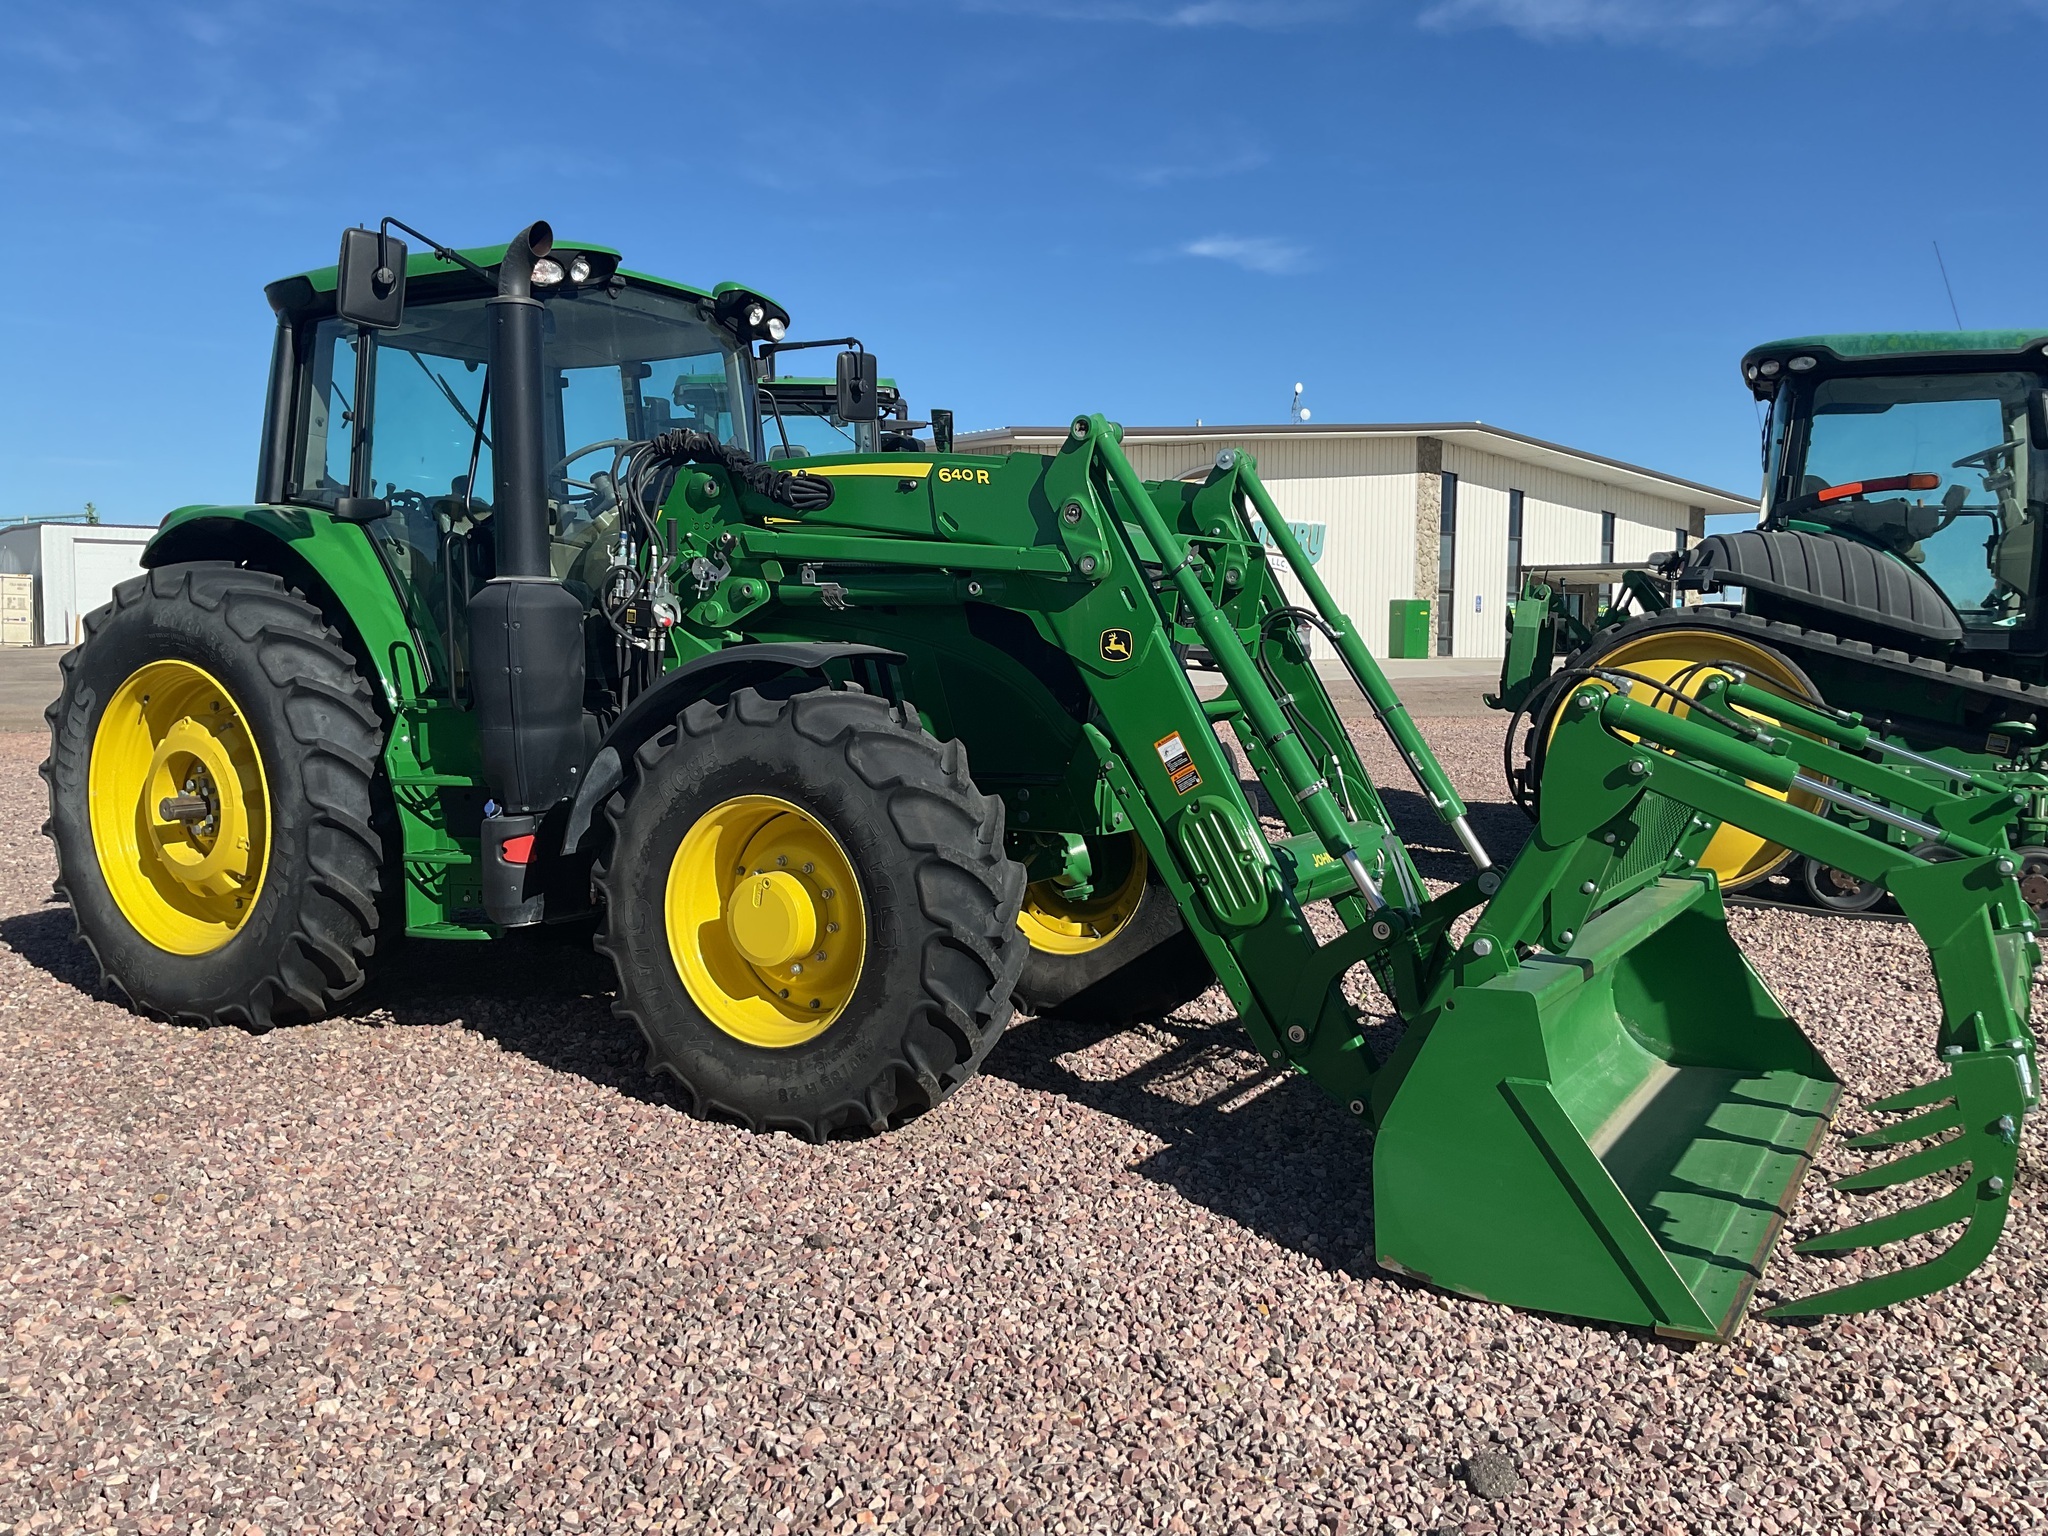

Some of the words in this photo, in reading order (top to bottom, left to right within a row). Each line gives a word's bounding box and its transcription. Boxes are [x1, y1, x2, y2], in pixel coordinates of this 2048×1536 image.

[938, 468, 974, 482] 640
[976, 469, 990, 485] R
[1271, 557, 1289, 569] LLC.
